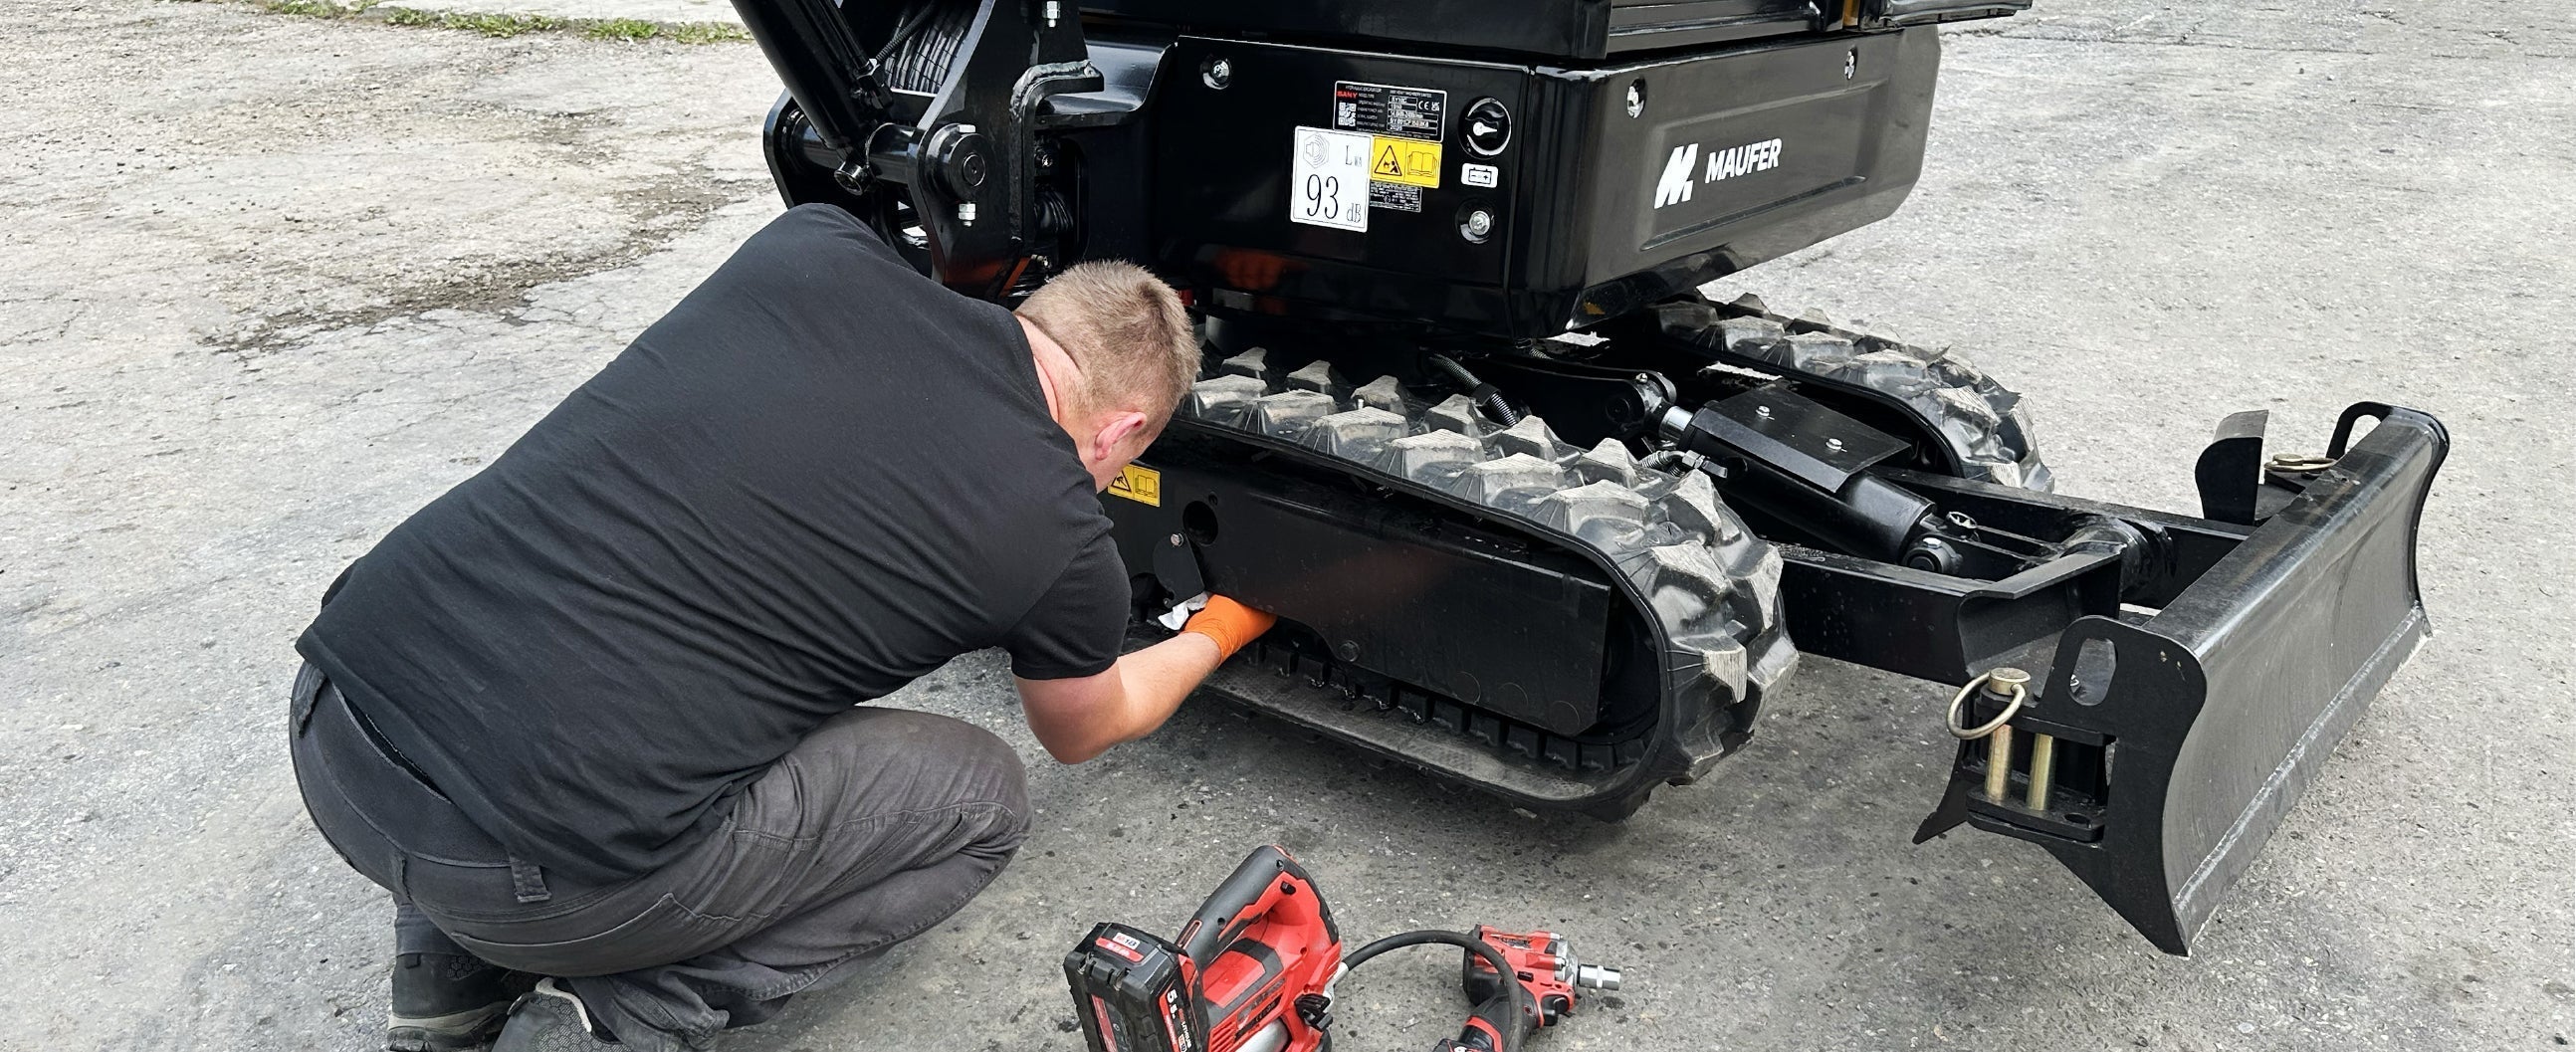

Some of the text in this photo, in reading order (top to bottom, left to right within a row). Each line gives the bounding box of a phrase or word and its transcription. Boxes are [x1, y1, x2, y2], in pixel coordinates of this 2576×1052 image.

[1704, 137, 1783, 184] MAUFER
[1306, 173, 1339, 219] 93
[1346, 202, 1362, 223] dB
